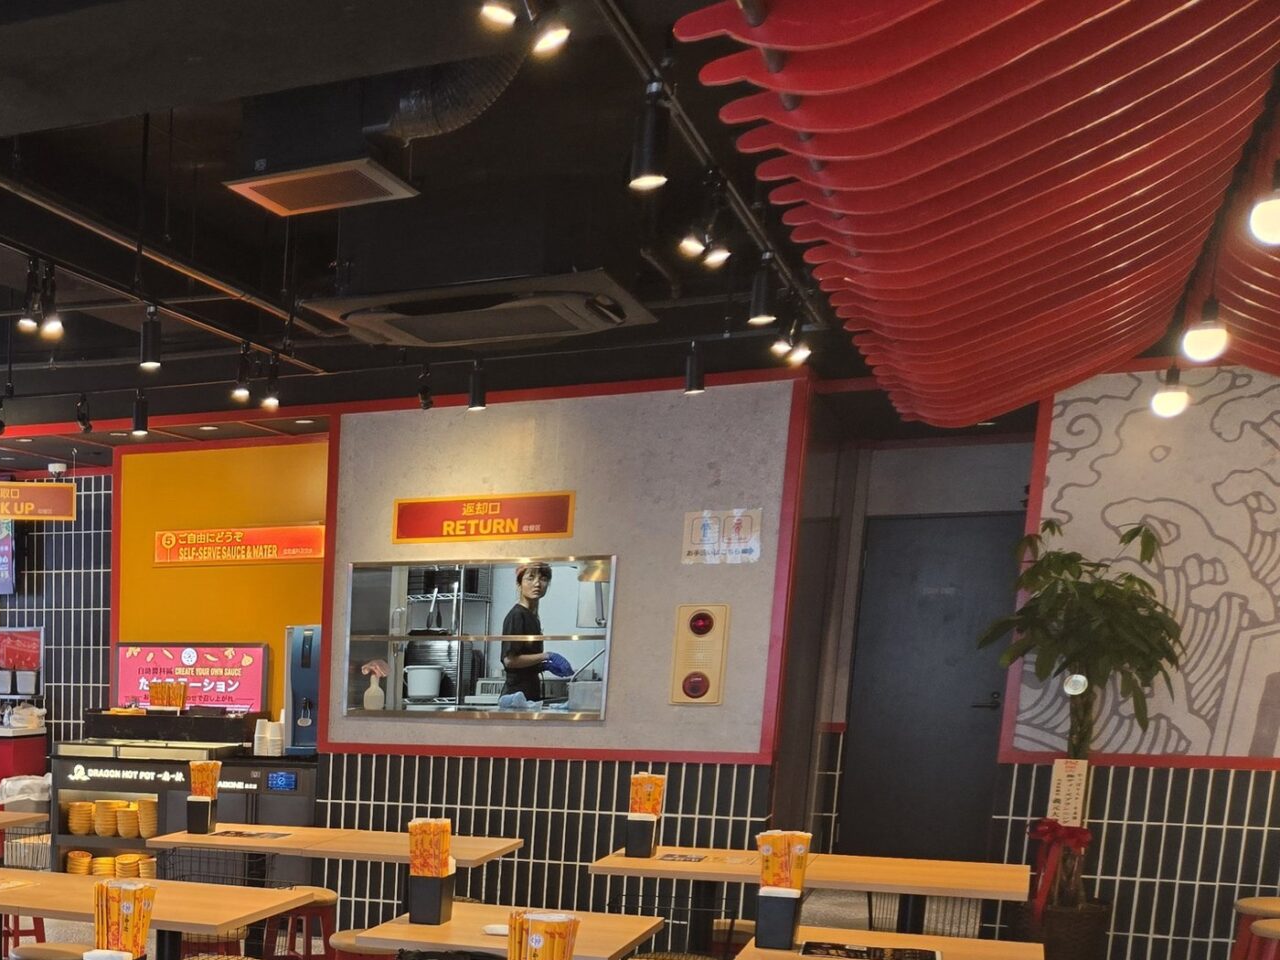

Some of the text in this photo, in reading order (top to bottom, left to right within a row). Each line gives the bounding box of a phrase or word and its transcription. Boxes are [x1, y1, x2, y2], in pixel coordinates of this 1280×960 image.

[14, 502, 35, 515] UP
[462, 502, 501, 516] 返却口
[442, 518, 519, 535] RETURN
[178, 531, 244, 545] ご自由にどうぞ
[178, 545, 221, 561] SELF-SERVE
[221, 545, 246, 560] SAUCE
[253, 544, 278, 559] WATER
[174, 667, 194, 676] CREATE
[195, 667, 210, 676] YOUR
[210, 667, 223, 676] OWN
[224, 667, 242, 676] SAUCE
[87, 768, 121, 778] DRAGON
[121, 770, 138, 780] HOT
[139, 771, 156, 781] POT
